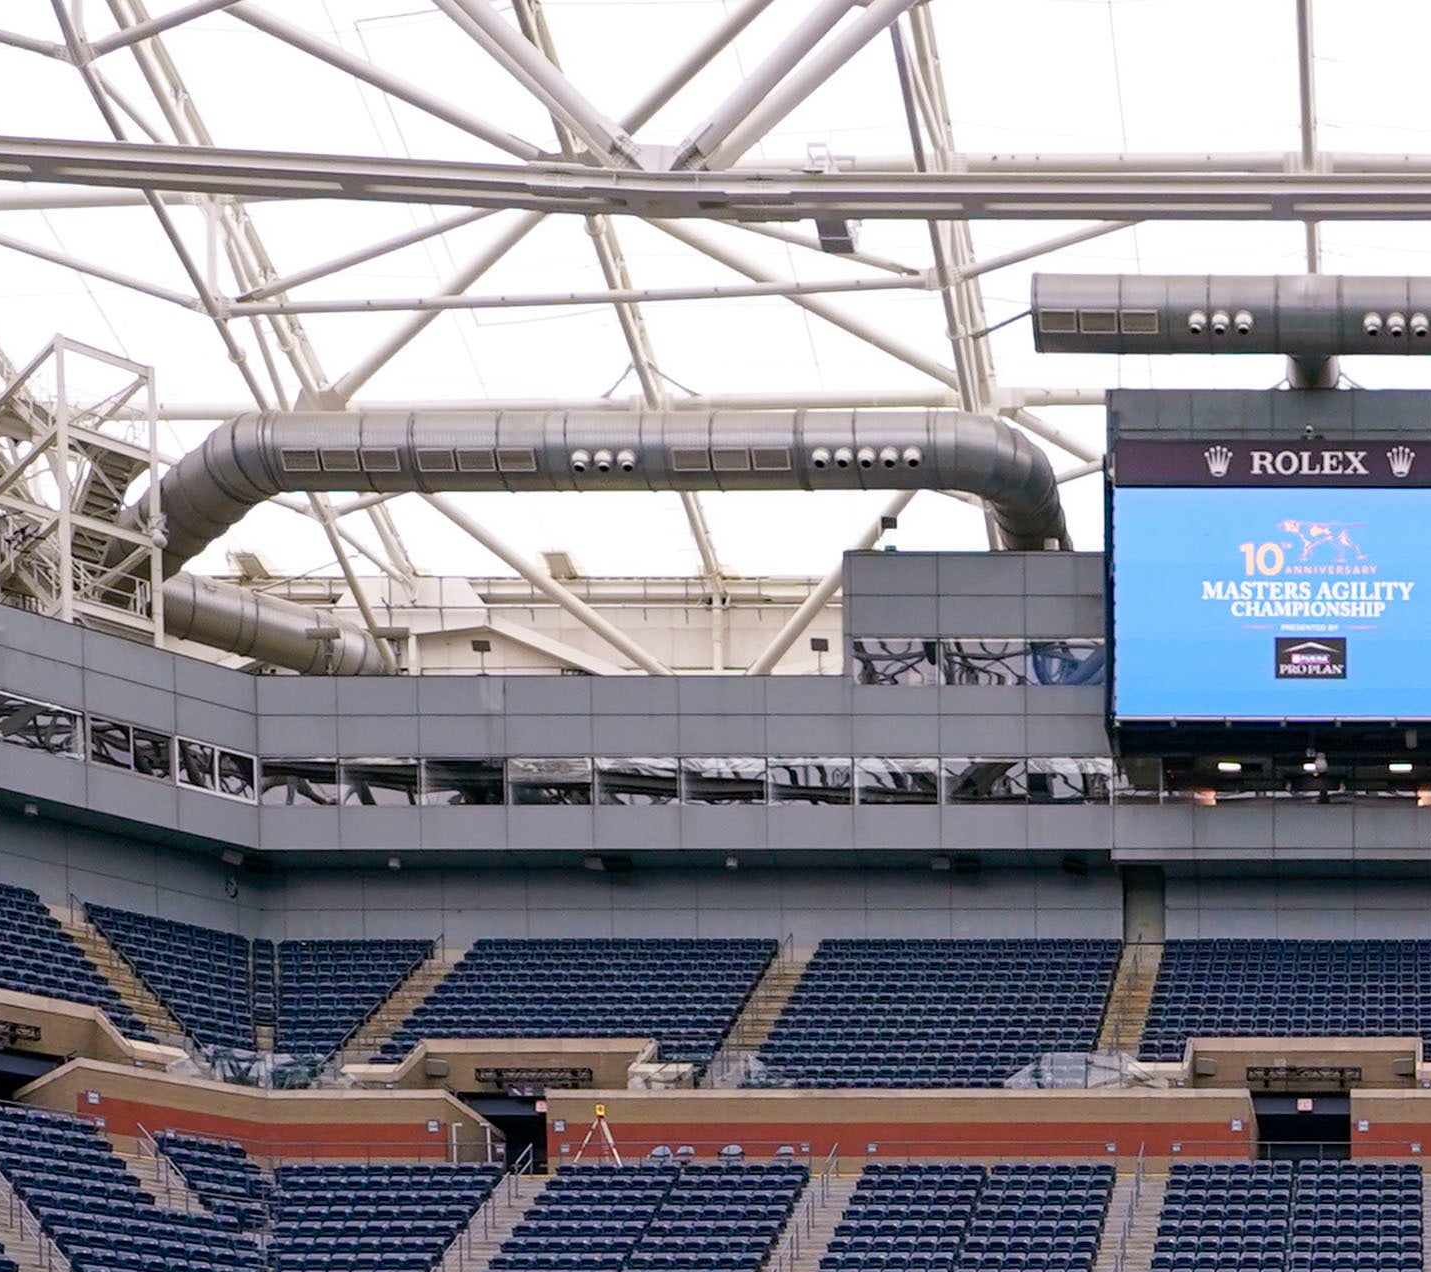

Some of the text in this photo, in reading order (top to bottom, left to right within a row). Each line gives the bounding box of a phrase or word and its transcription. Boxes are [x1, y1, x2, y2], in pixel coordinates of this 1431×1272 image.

[1250, 451, 1369, 475] ROLEX
[1285, 565, 1377, 575] ANNIVERSARY
[1201, 581, 1415, 601] MASTERS AGILITY
[1230, 601, 1386, 618] CHAMPIONSHIP
